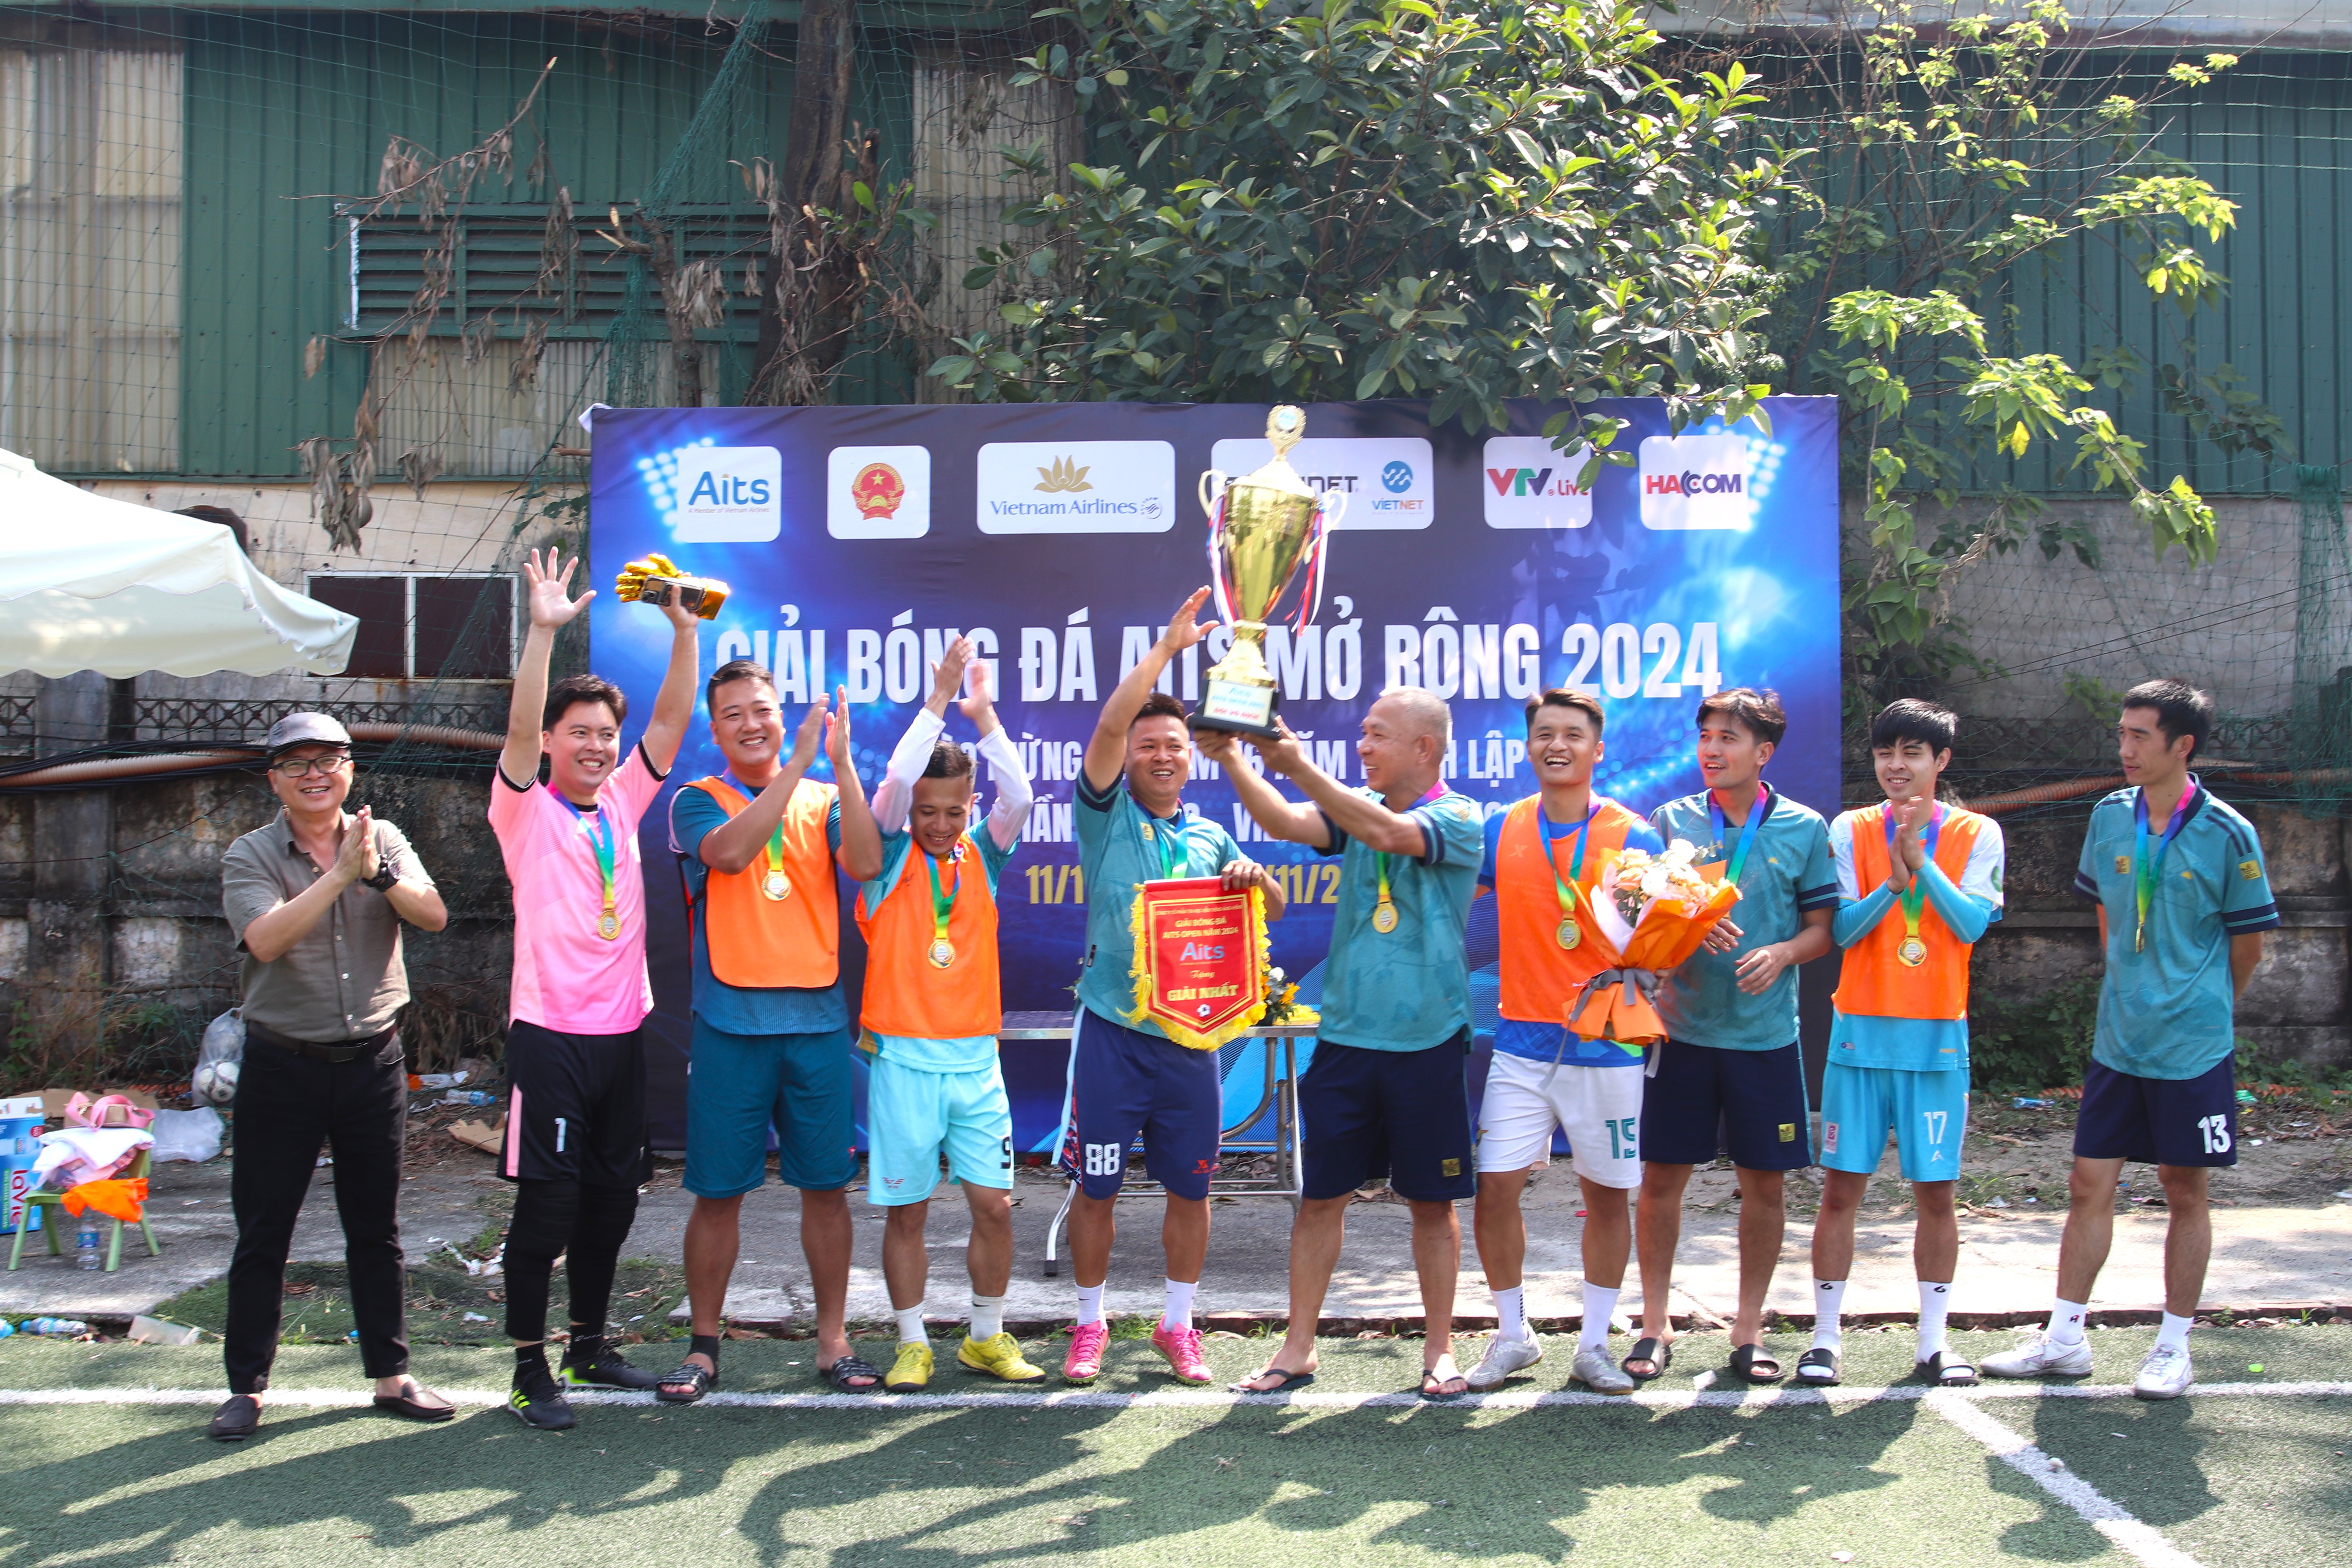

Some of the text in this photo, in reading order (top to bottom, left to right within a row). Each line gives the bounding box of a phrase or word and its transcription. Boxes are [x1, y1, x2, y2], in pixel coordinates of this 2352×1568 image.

[688, 471, 770, 505] Aits
[1486, 468, 1588, 496] VTV Liv
[990, 501, 1066, 515] Vietnam
[1070, 498, 1137, 514] Airlines
[1018, 606, 1098, 702] ĐÁ
[1265, 595, 1363, 701] MỞ
[1561, 622, 1722, 699] 2024
[1468, 730, 1525, 788] LẬP
[1180, 942, 1224, 960] Aits
[1167, 981, 1239, 1002] GIẢI NHẤT
[554, 1118, 567, 1152] 1
[1604, 1117, 1636, 1159] 15
[1923, 1111, 1947, 1145] 17
[2197, 1114, 2232, 1154] 13
[1085, 1143, 1121, 1176] 88
